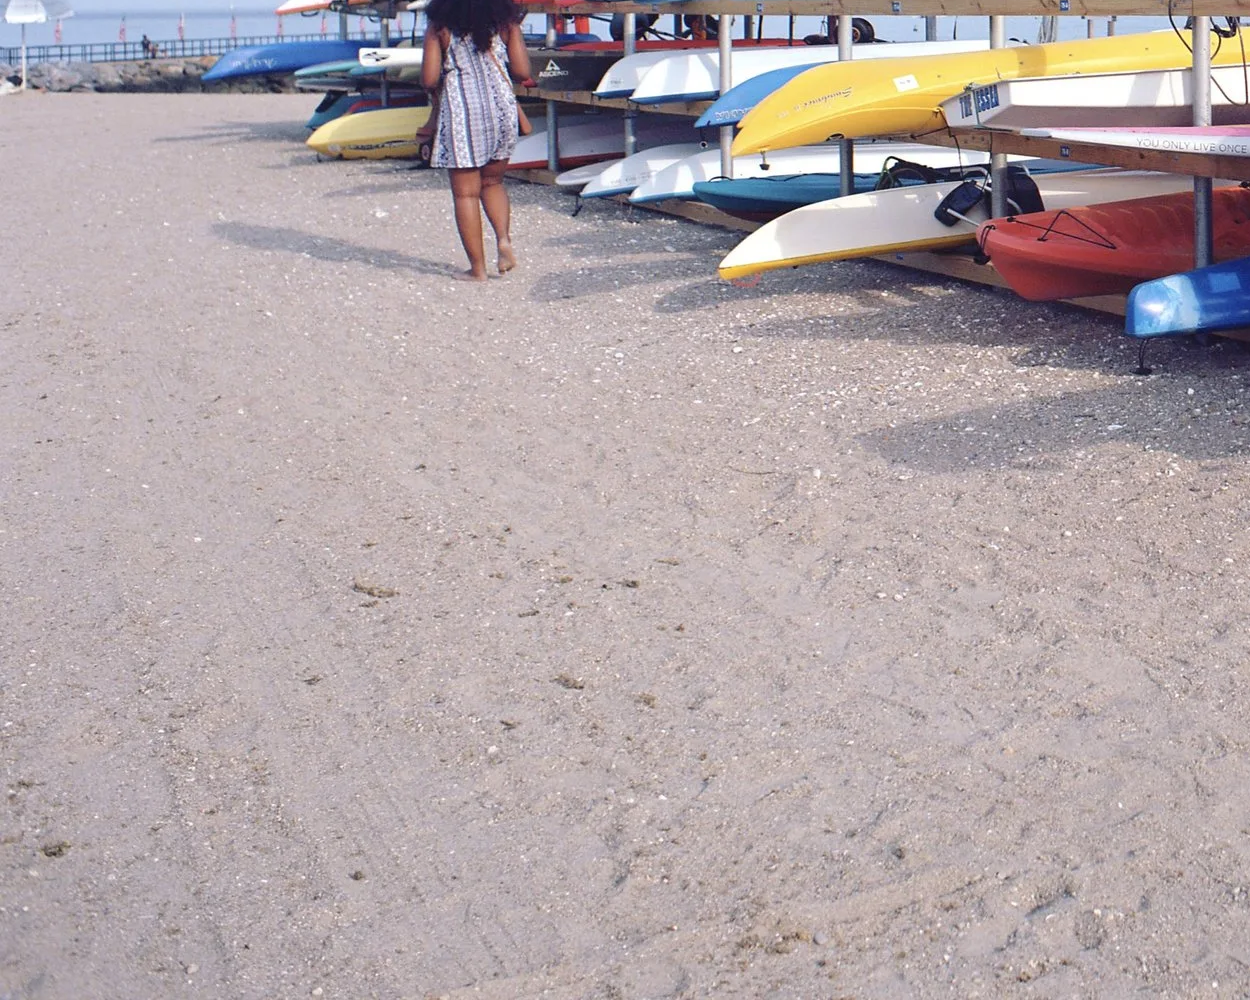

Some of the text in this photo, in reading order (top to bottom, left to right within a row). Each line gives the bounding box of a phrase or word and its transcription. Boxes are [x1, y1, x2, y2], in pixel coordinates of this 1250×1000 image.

[1136, 137, 1248, 154] YOU ONLY LIVE ONCE
